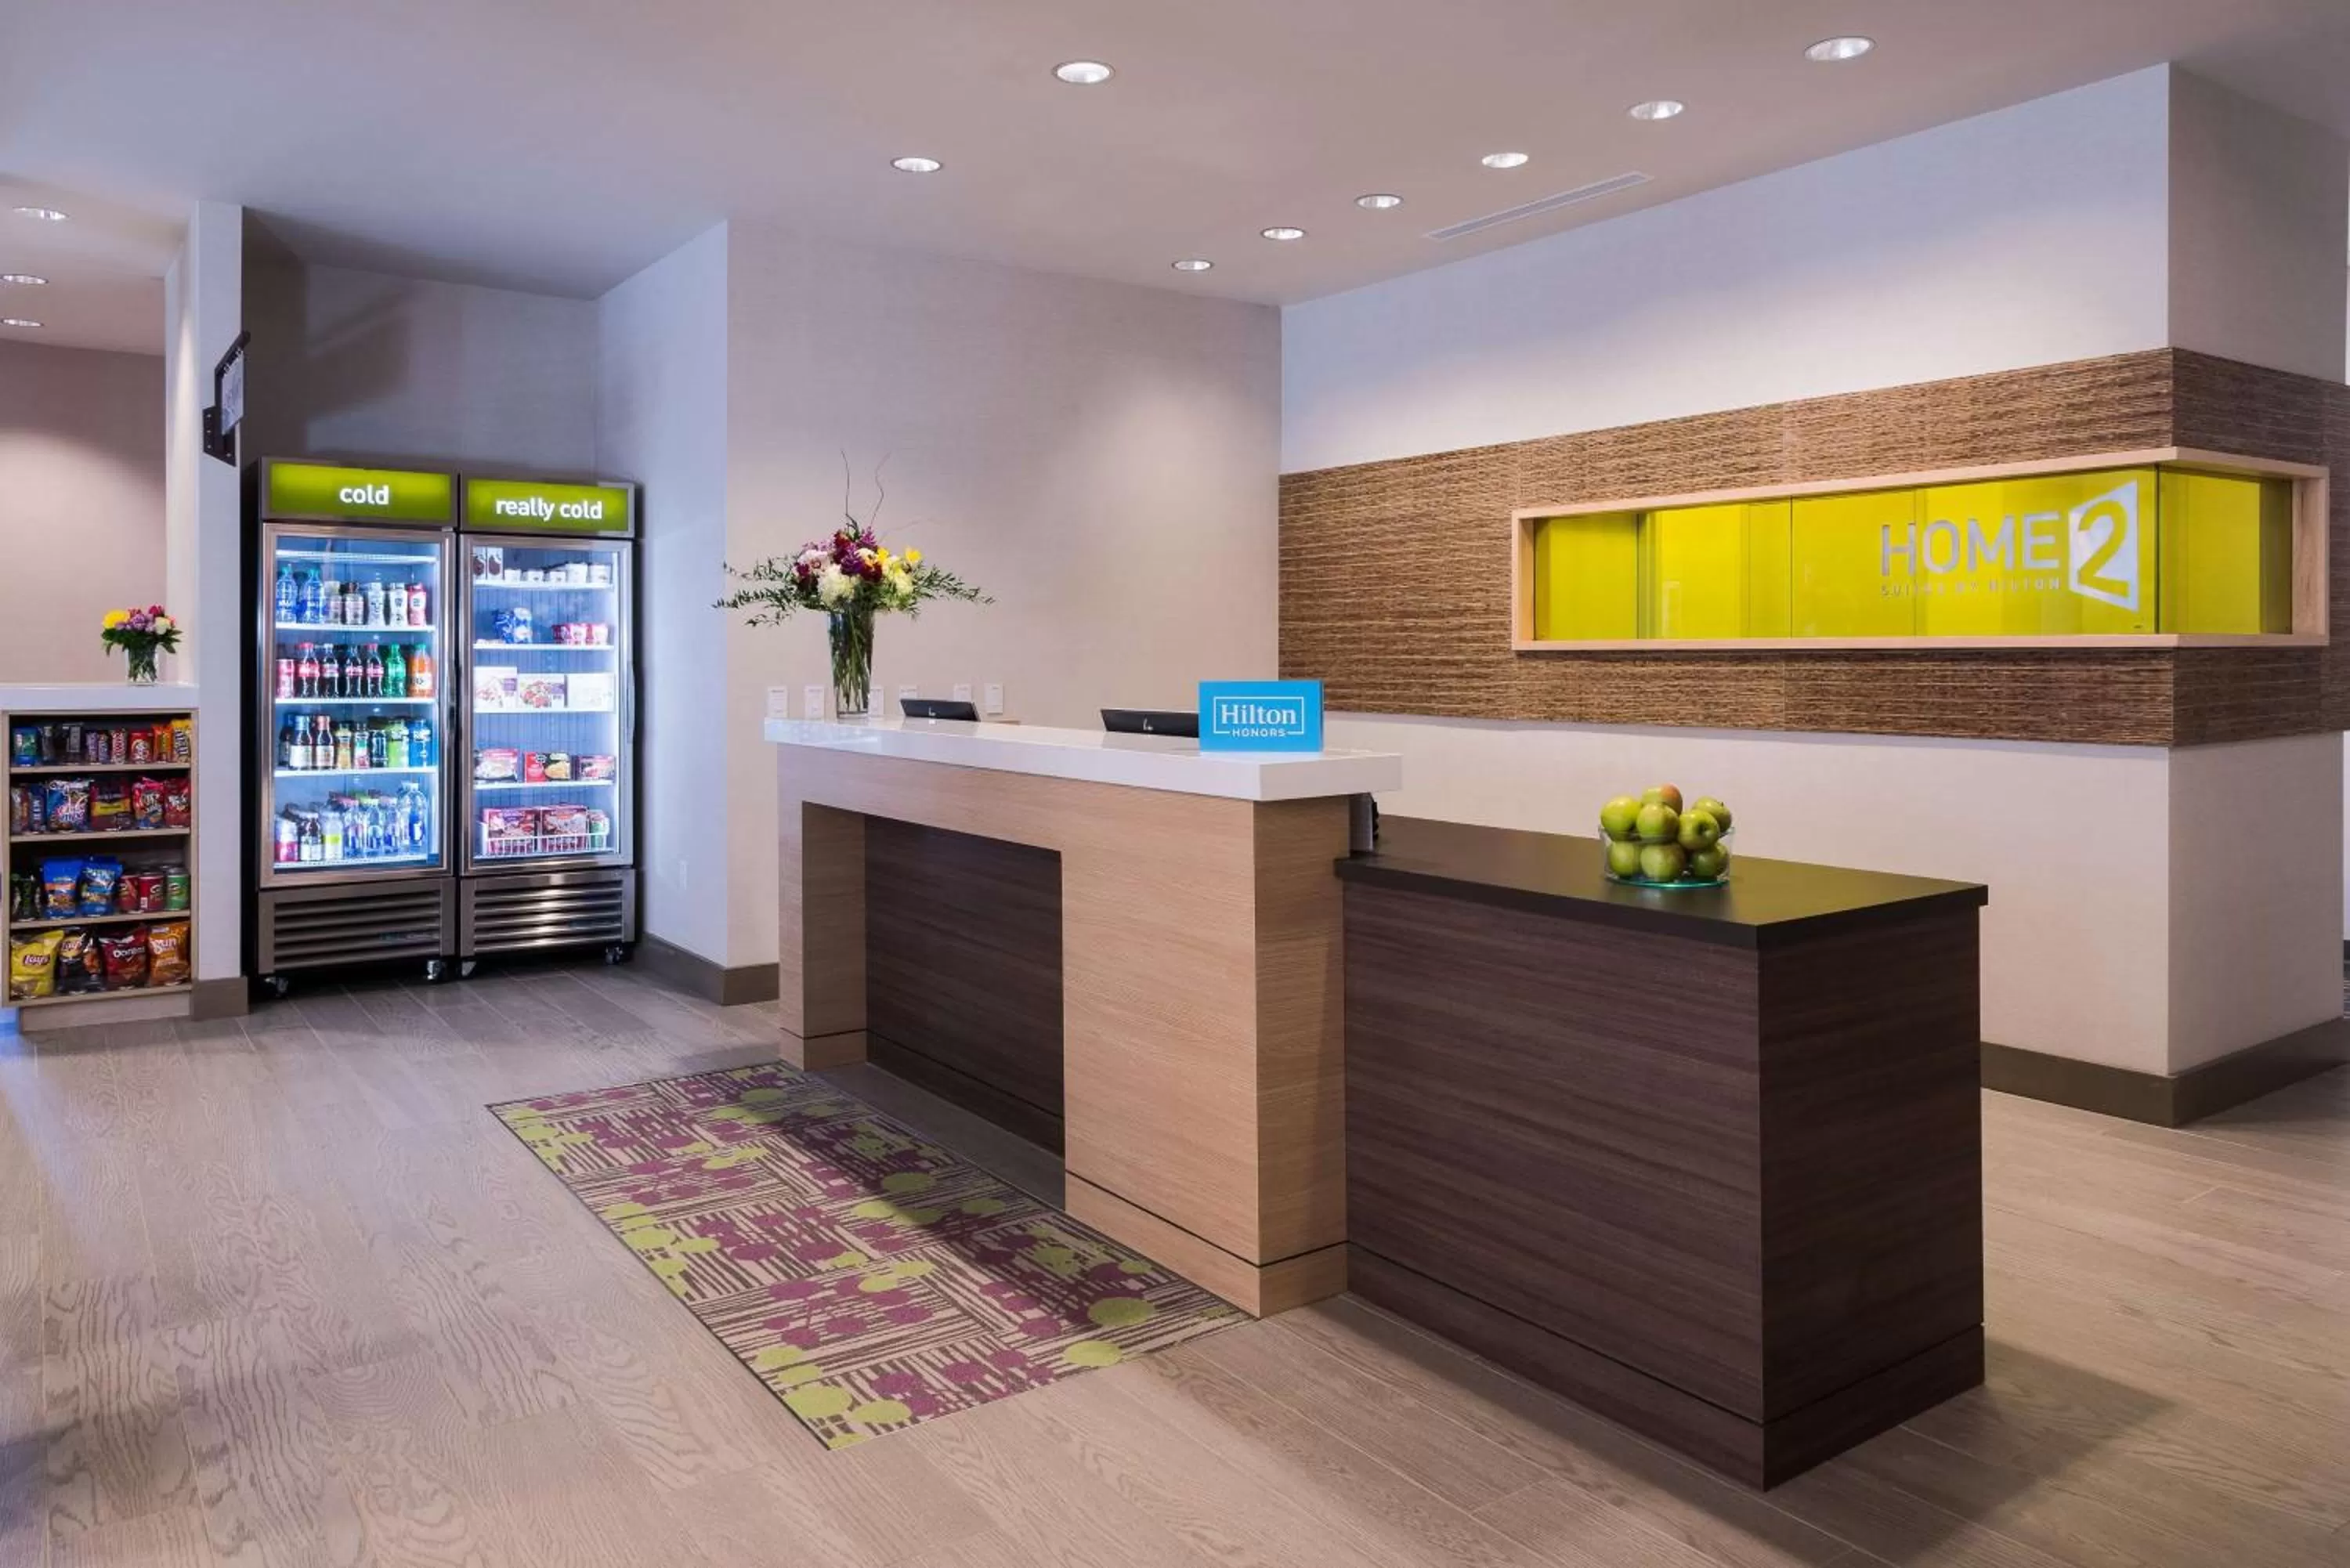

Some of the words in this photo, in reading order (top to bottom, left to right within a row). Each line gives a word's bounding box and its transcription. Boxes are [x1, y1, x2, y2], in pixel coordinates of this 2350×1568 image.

[339, 483, 389, 505] cold
[496, 497, 555, 522] really
[560, 500, 602, 519] cold
[1882, 511, 2059, 576] HOME
[2077, 499, 2131, 598] 2
[1221, 703, 1297, 725] Hilton
[1232, 728, 1287, 737] HONORS
